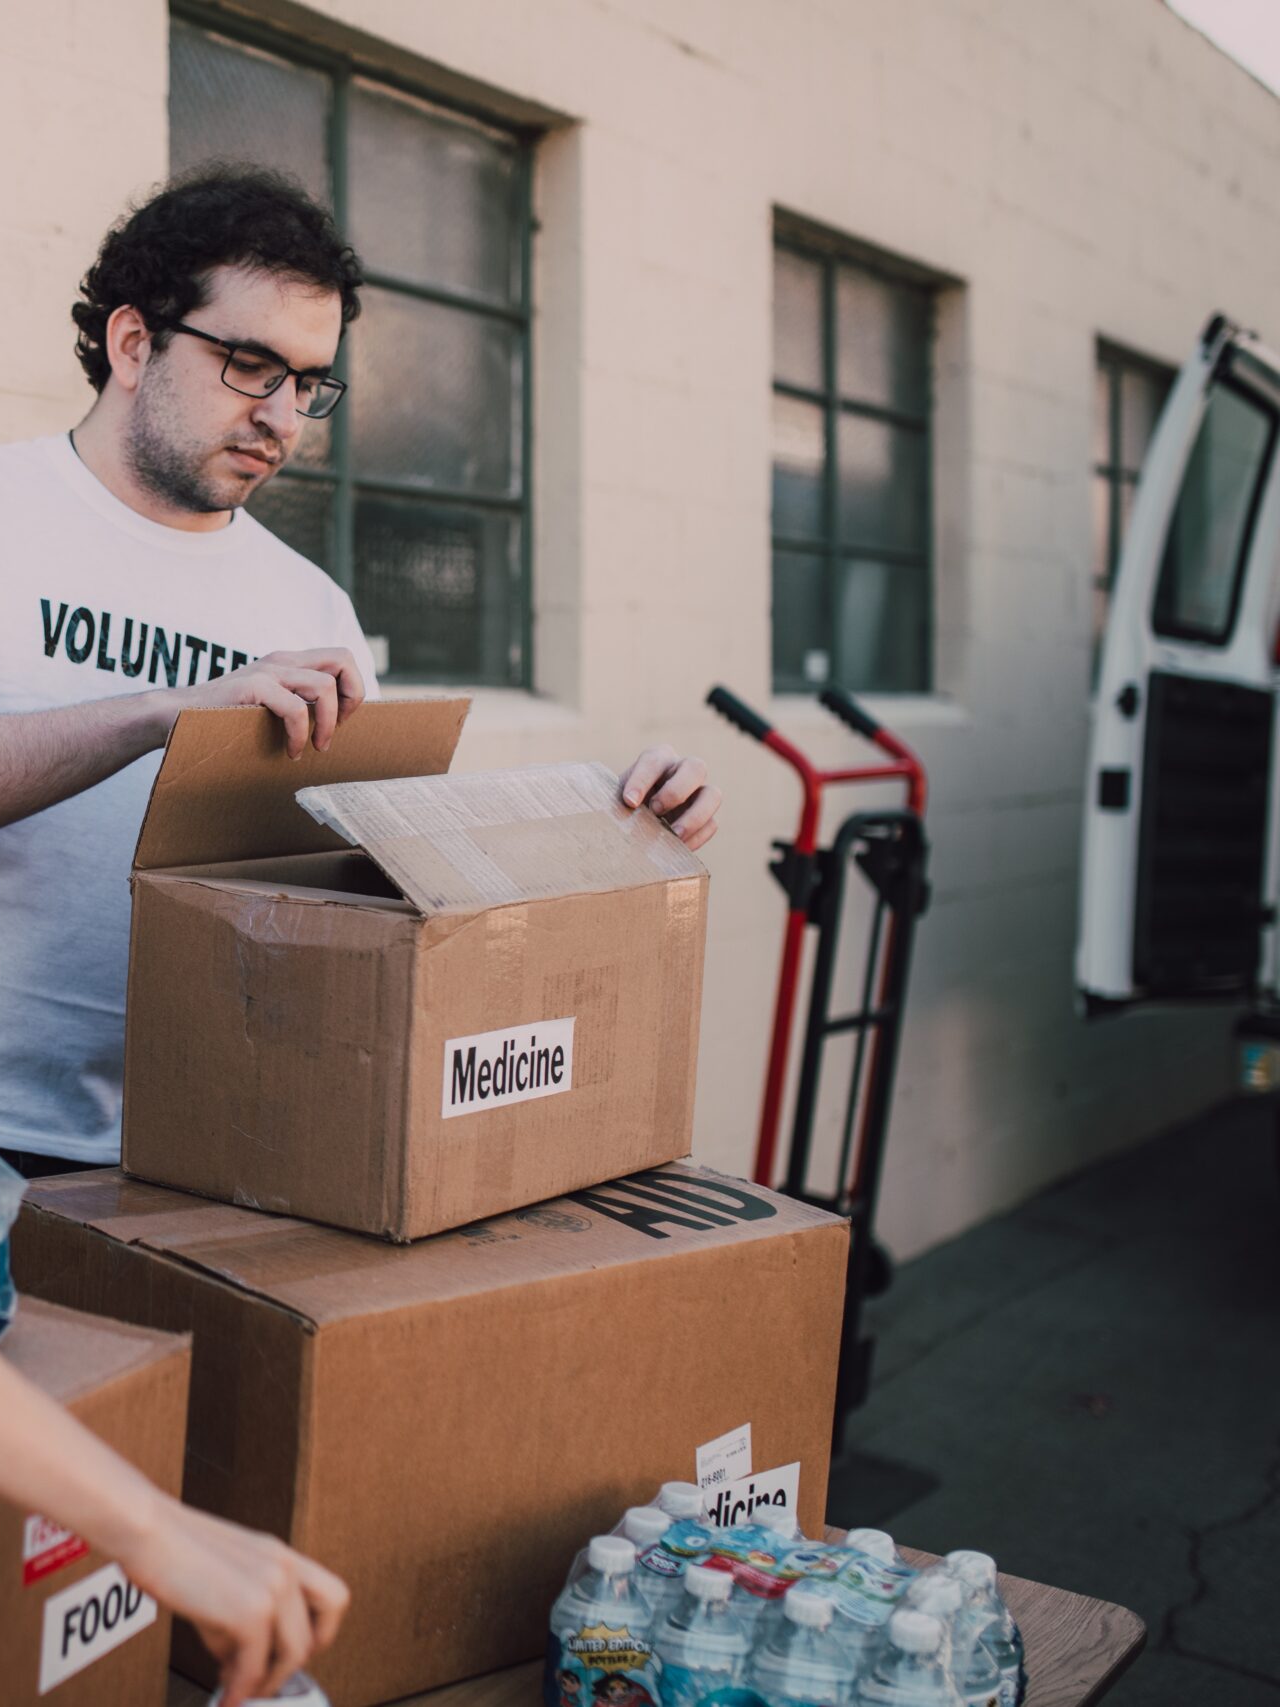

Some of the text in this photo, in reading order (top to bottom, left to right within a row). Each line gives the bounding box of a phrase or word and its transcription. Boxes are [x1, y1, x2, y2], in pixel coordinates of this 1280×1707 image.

[451, 1035, 564, 1105] Medicine
[565, 1171, 778, 1239] AID
[61, 1580, 143, 1658] FOOD
[568, 1636, 607, 1653] LIMITED
